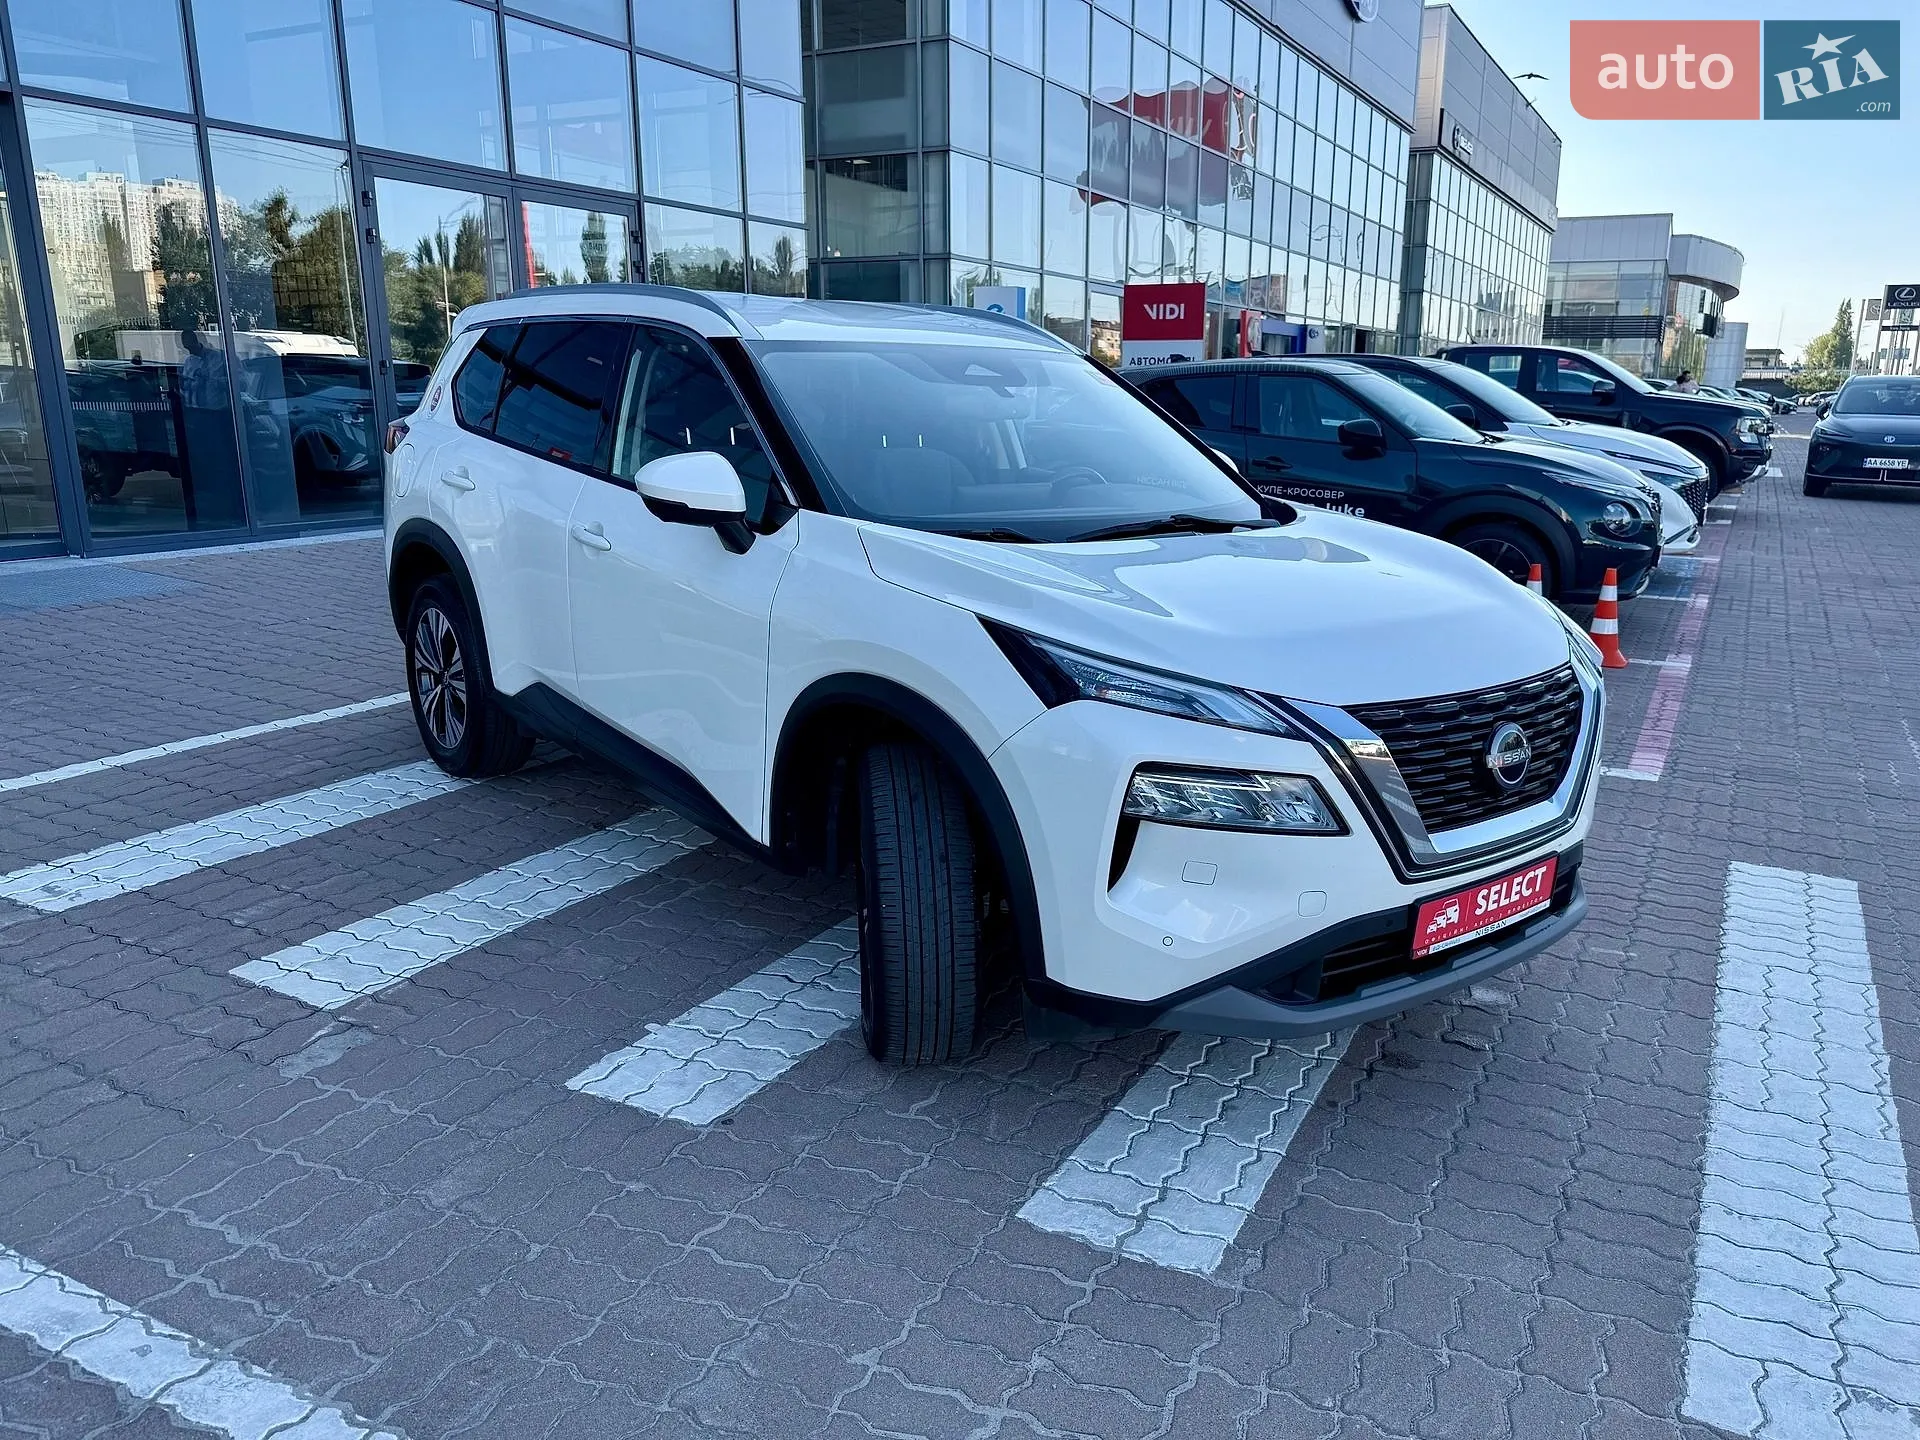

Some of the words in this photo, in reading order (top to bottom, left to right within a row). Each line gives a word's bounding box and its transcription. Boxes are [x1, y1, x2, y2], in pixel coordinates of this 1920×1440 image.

[1143, 303, 1185, 320] VIDI
[1257, 485, 1345, 499] КУПЕ-КРОСОВЕР
[1488, 747, 1531, 768] NISSAN
[1475, 866, 1547, 916] SELECT
[1475, 920, 1507, 937] NISSAN
